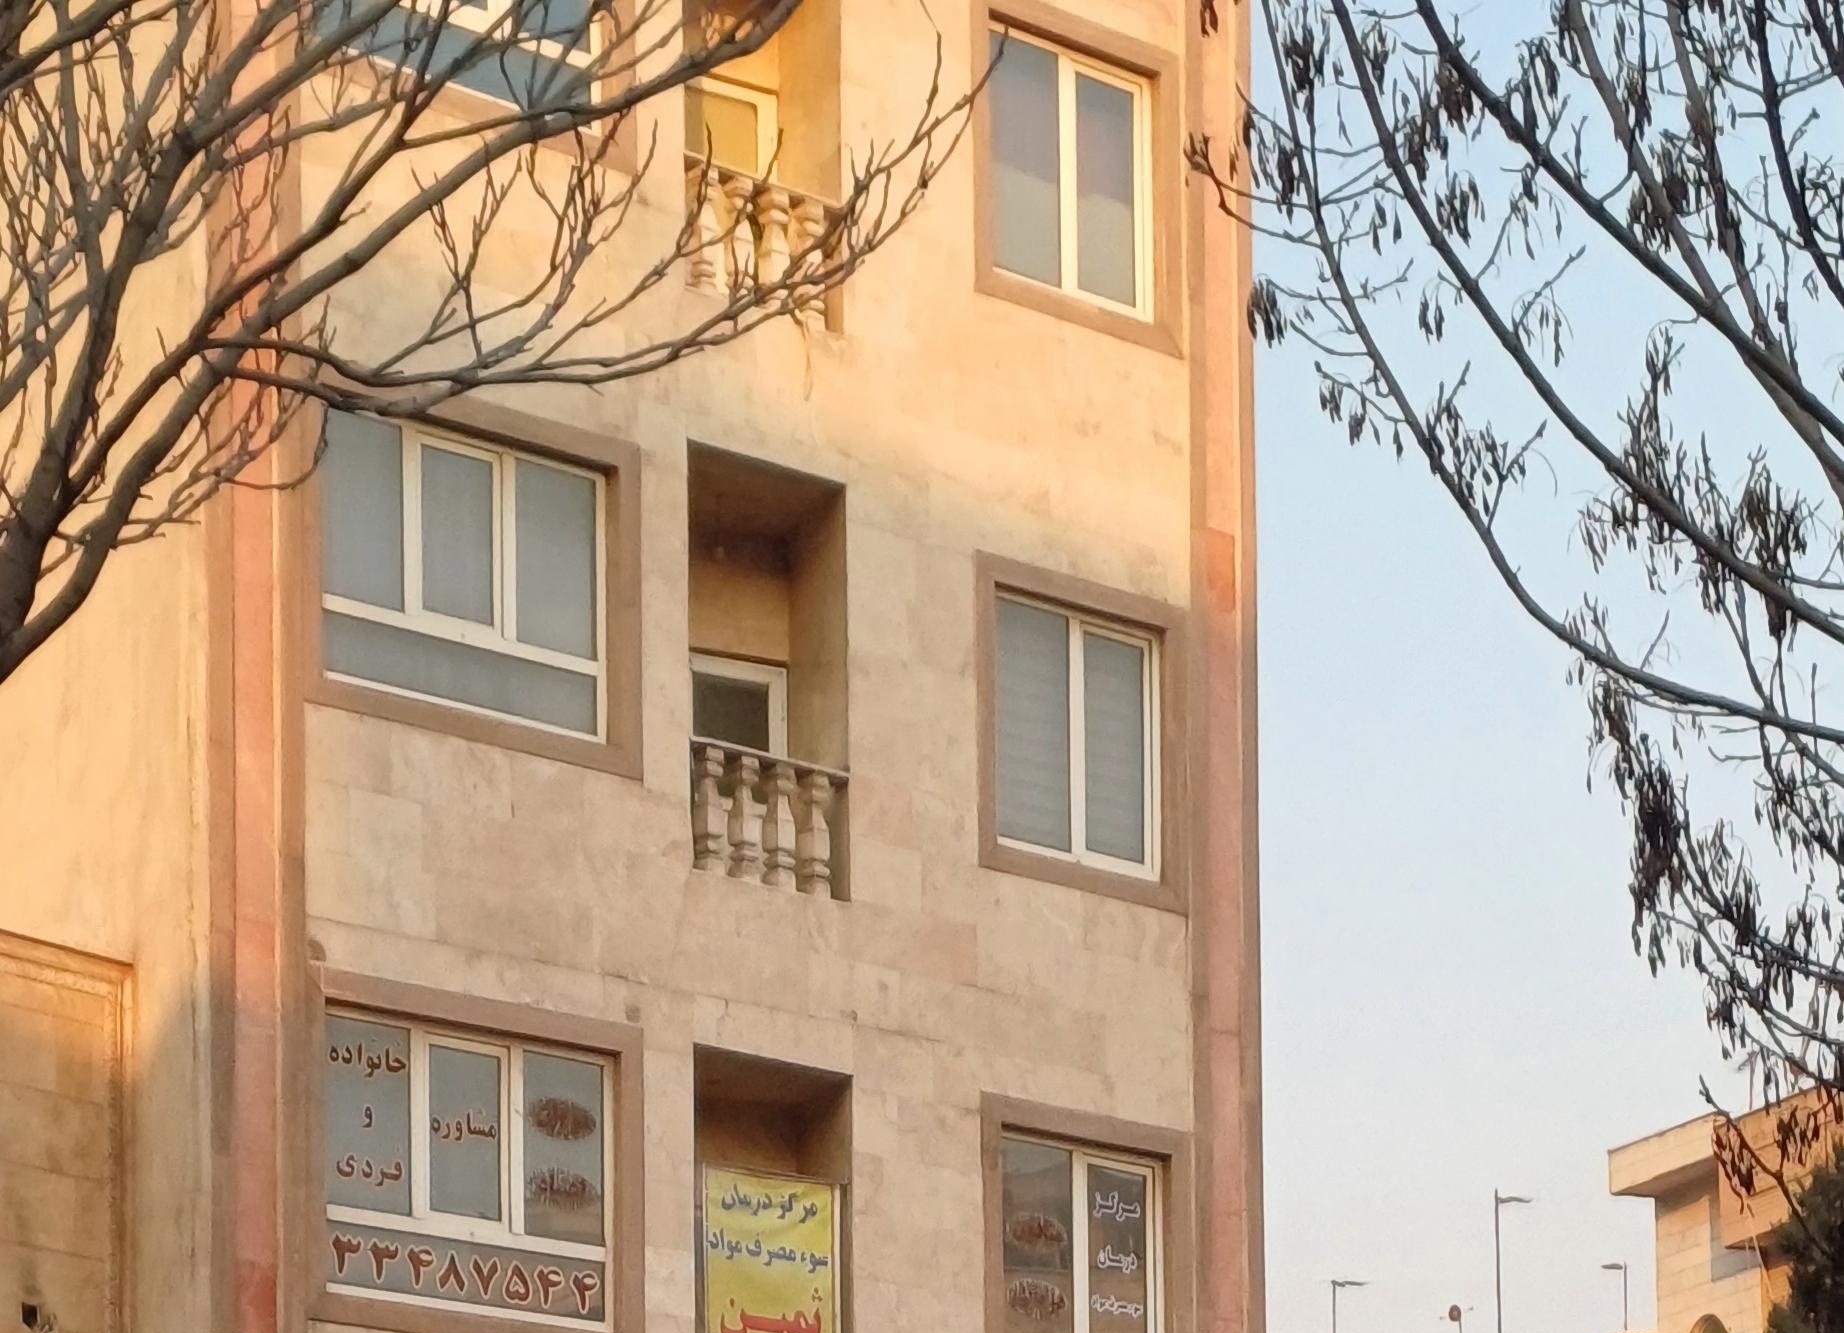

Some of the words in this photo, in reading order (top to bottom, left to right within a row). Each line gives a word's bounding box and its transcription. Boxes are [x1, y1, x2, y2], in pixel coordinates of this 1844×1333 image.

[328, 1036, 408, 1078] خانواده
[360, 1103, 373, 1129] و
[430, 1108, 498, 1142] مشاوره
[335, 1150, 404, 1187] فردی
[721, 1184, 774, 1217] درمان
[777, 1190, 818, 1224] مرکز
[746, 1233, 797, 1267] مصرف
[801, 1250, 829, 1274] سوء
[330, 1232, 600, 1315] ۳۳۴۸۷۵۴۴
